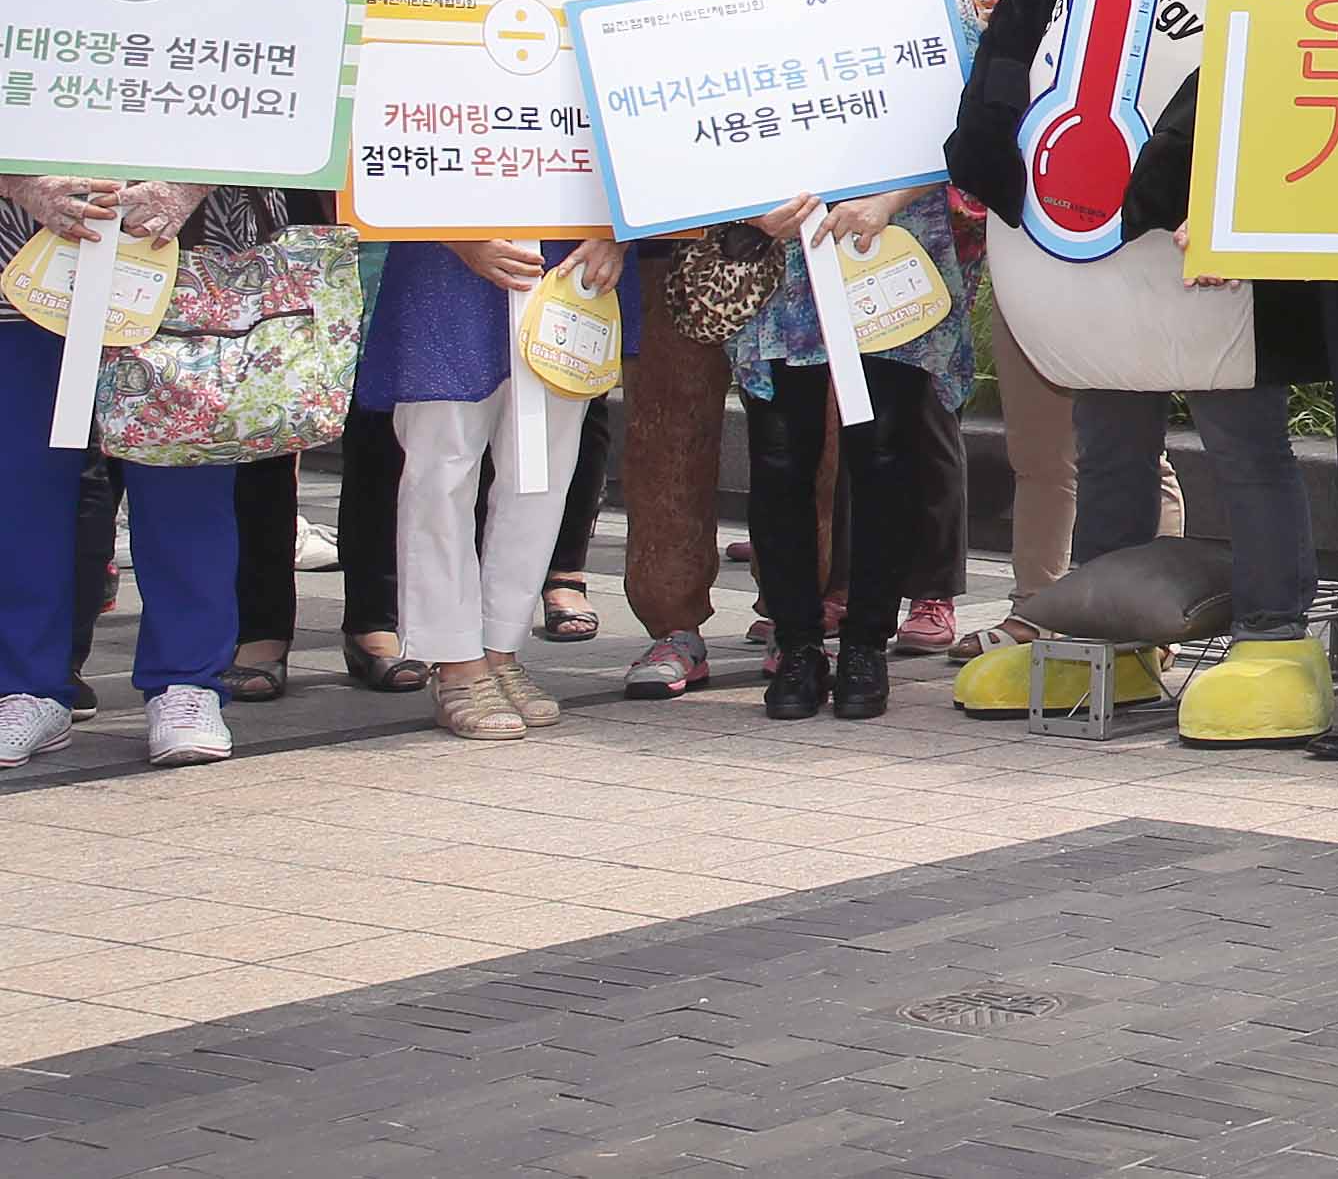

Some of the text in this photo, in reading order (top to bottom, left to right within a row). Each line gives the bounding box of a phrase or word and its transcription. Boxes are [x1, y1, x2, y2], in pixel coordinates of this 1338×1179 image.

[166, 37, 296, 77] 설치하면
[607, 36, 948, 117] 에너지소비효율 1등급 제품
[48, 74, 297, 119] 생산할수있어요!
[384, 105, 543, 136] 카쉐어링으로
[693, 90, 889, 147] 사용을 부탁해!
[361, 146, 593, 178] 절약하고 온실가스도
